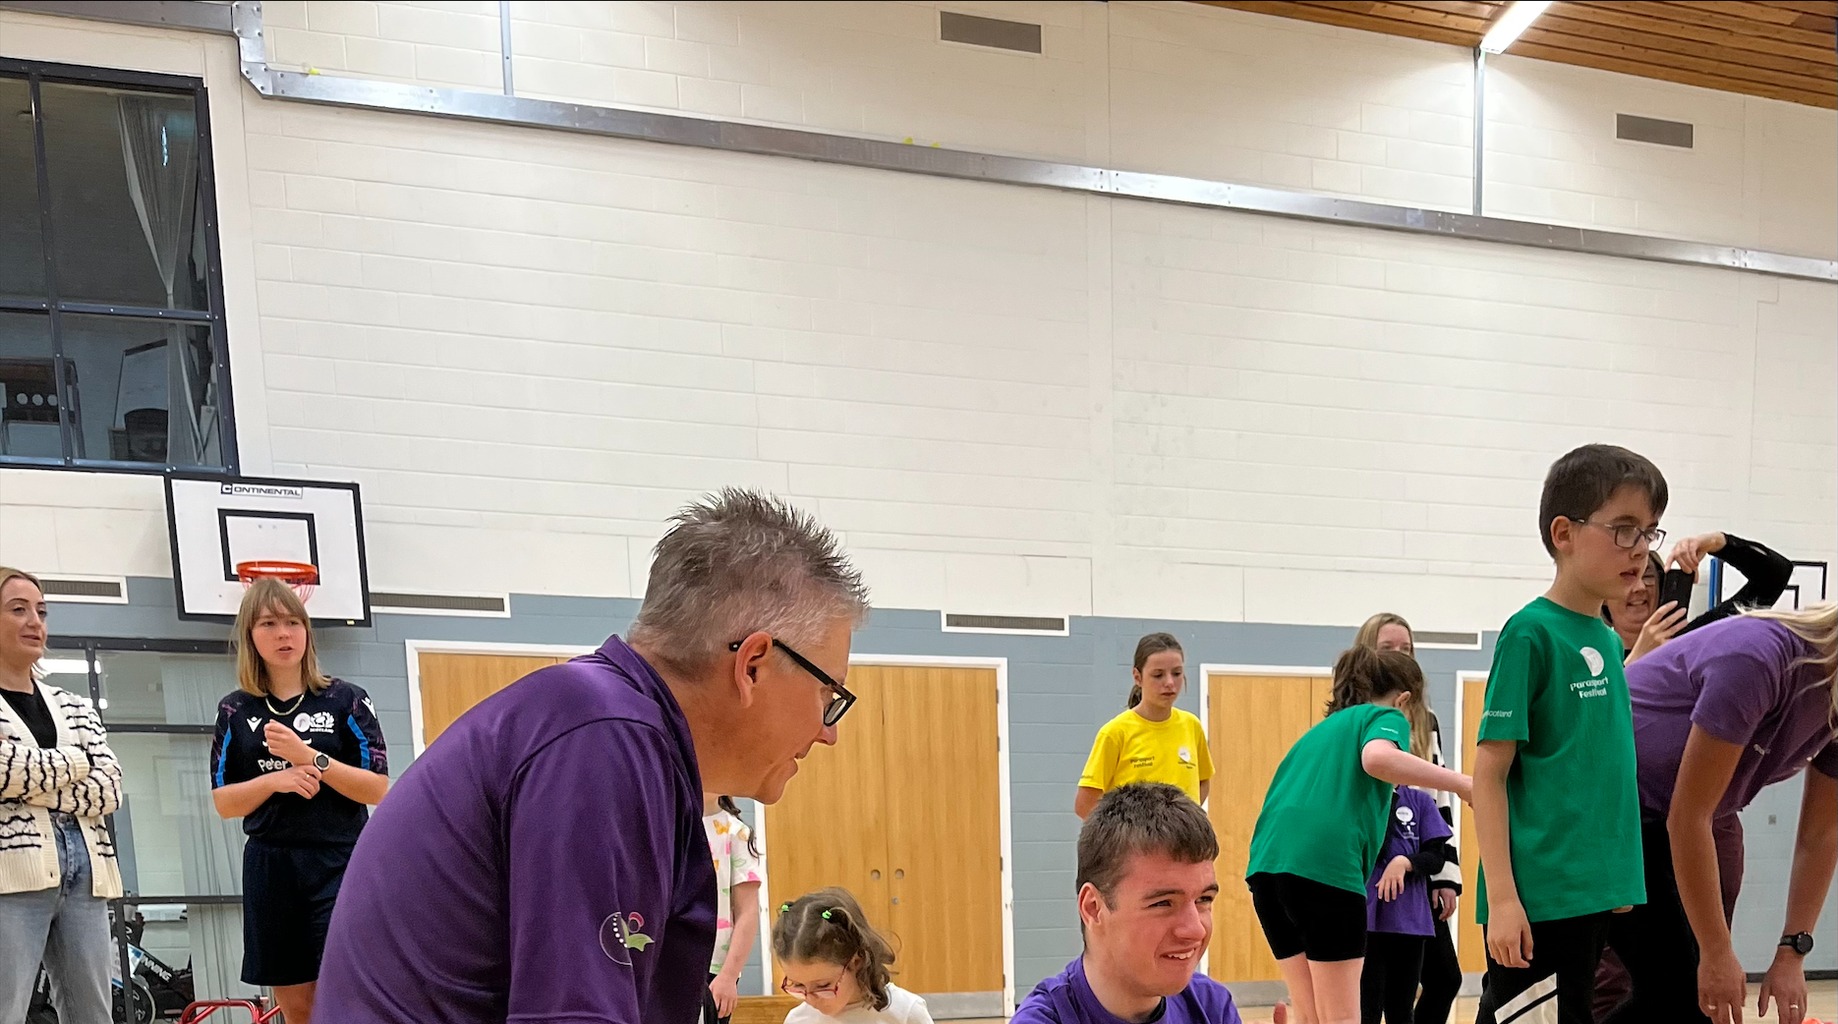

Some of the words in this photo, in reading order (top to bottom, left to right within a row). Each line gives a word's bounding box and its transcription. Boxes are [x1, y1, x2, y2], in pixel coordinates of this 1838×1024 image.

[221, 483, 301, 497] CONTINENTAL
[1570, 677, 1609, 691] Parasport
[1579, 688, 1607, 699] Festival
[257, 758, 290, 773] Peter
